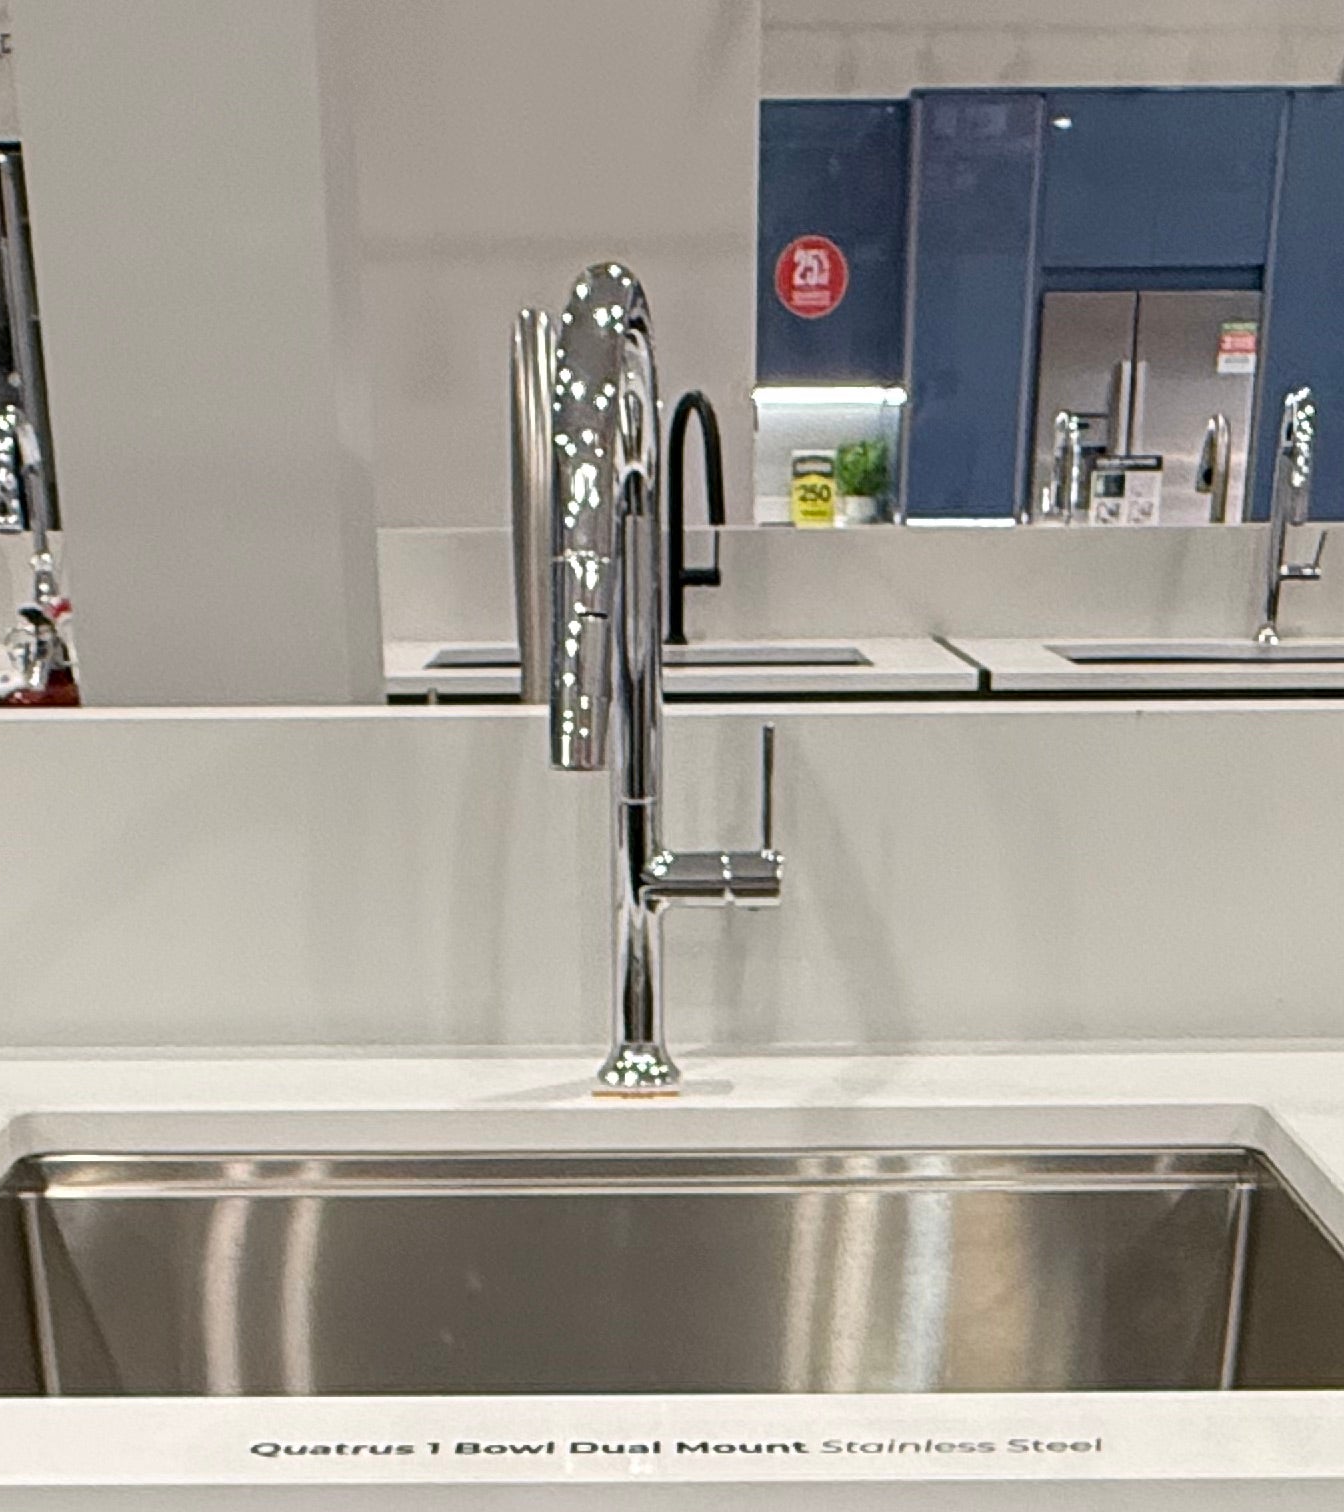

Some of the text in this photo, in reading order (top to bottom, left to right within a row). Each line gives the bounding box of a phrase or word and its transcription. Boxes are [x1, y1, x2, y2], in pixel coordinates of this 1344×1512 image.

[798, 484, 832, 503] 250
[250, 1437, 1104, 1458] Quatrus 1 Bowl Dual Mount Stainless Steel
